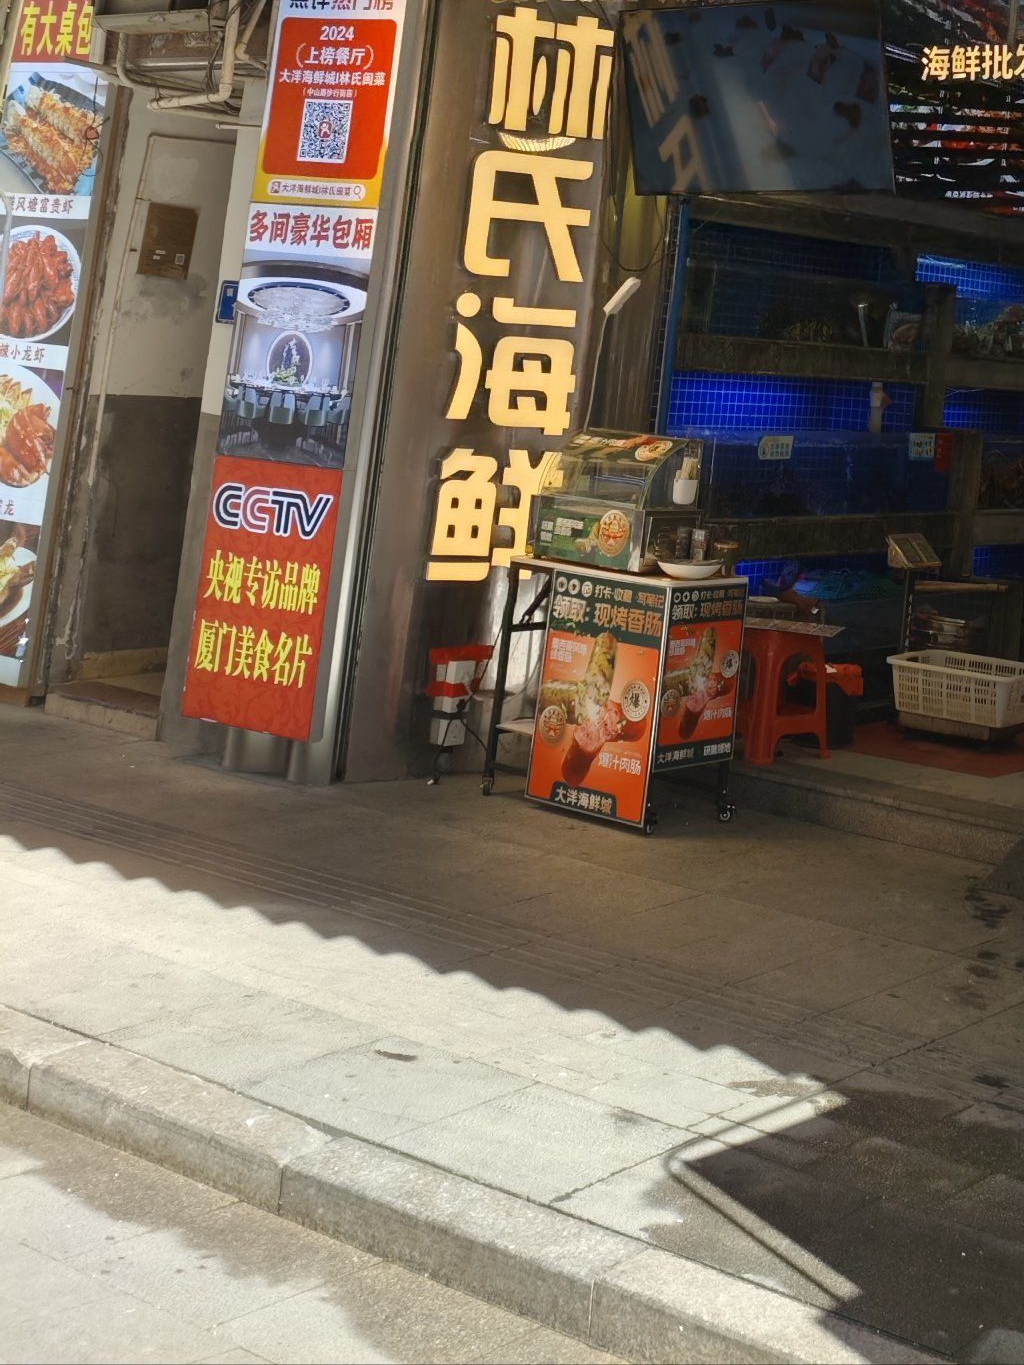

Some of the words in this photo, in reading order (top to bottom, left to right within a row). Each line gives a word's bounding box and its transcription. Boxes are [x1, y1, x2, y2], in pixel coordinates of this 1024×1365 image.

[320, 25, 355, 41] 2024
[249, 210, 374, 251] 多间豪华包厢
[426, 7, 614, 582] 林氏海鲜
[213, 482, 334, 540] CCTV
[203, 550, 321, 615] 央视专访品牌
[194, 618, 313, 690] 厦门美食名片
[554, 786, 613, 816] 大洋海鲜城
